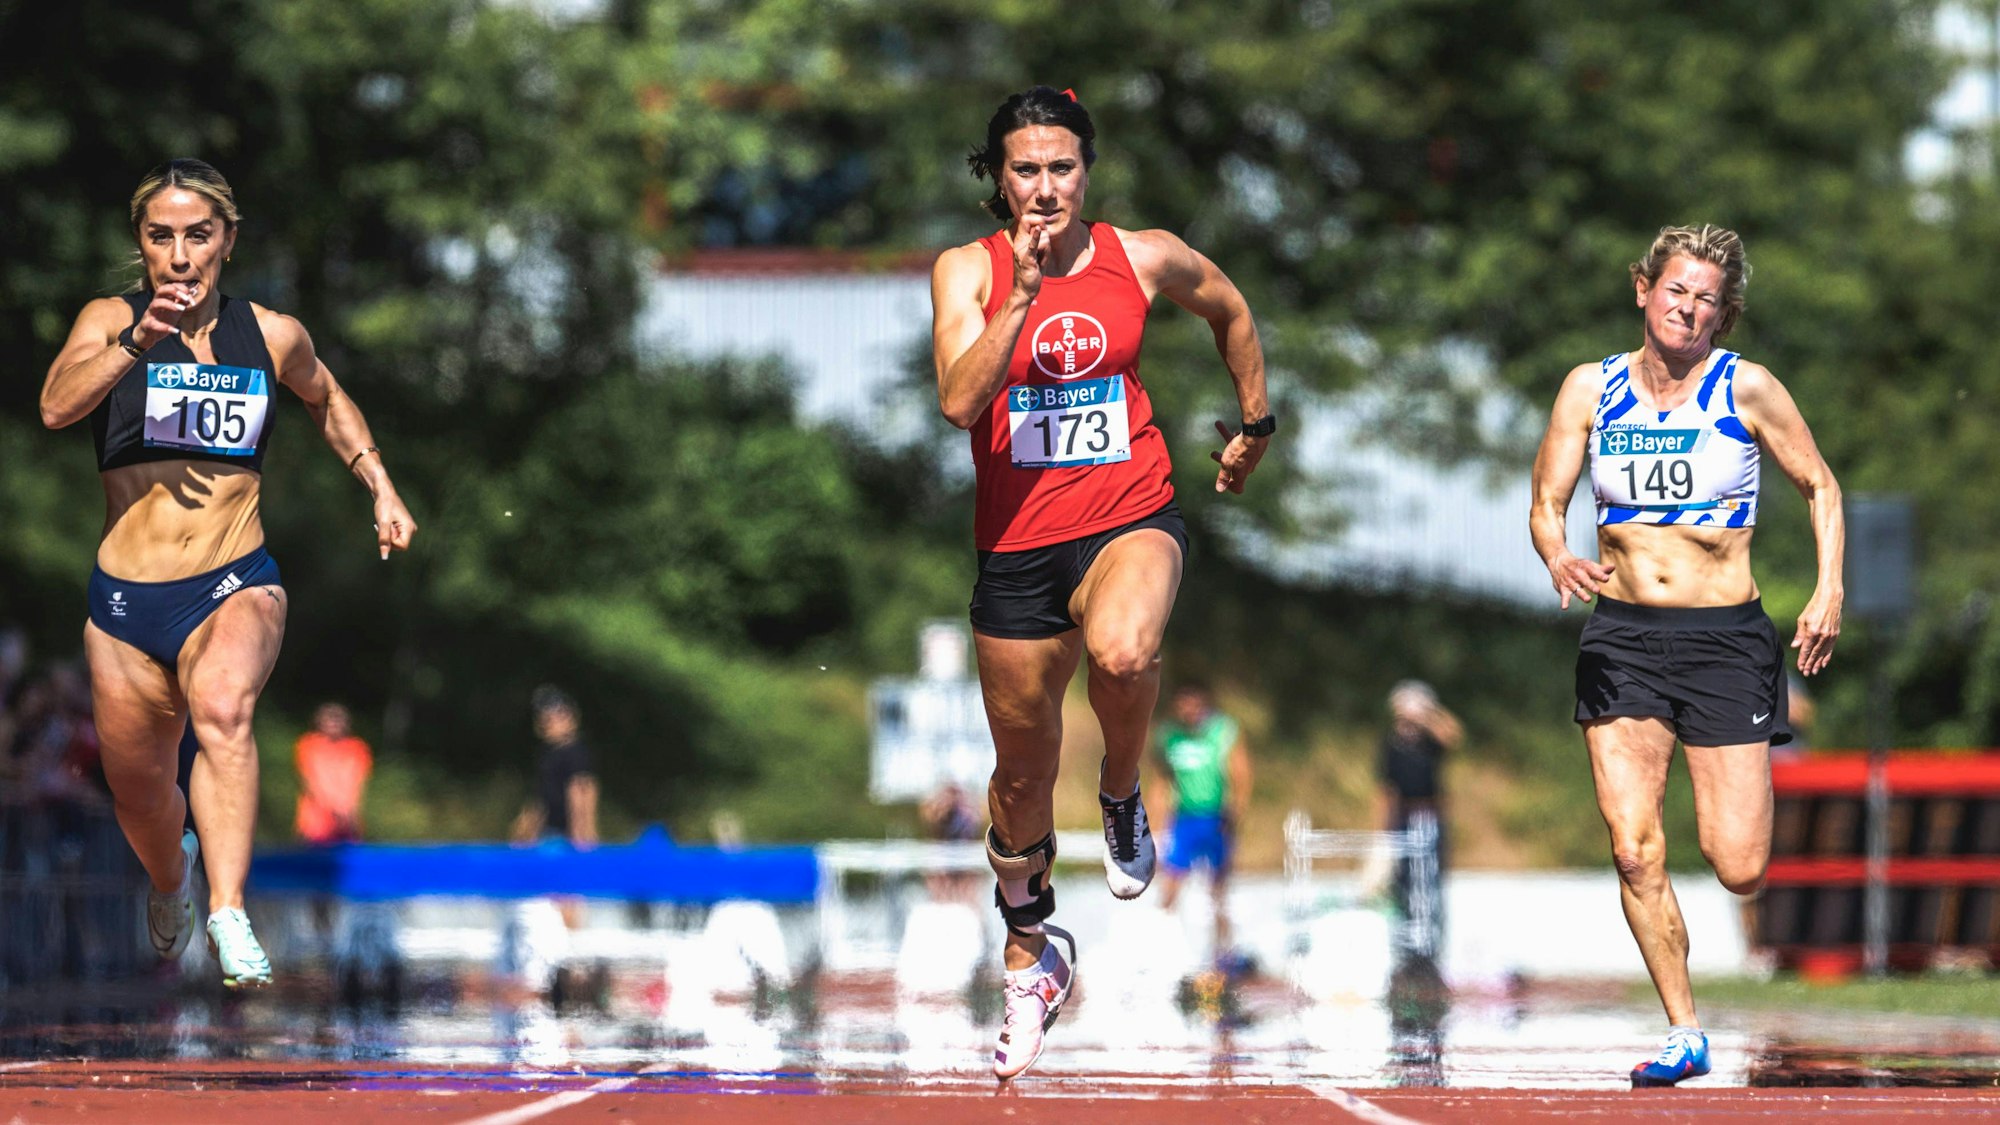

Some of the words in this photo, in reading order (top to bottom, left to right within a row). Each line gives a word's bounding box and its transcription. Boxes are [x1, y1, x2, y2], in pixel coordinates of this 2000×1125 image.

[1038, 336, 1101, 354] BAYER
[1062, 317, 1076, 373] BAYER
[185, 367, 239, 391] Bayer
[1044, 386, 1097, 407] Bayer
[172, 396, 246, 444] 105
[1033, 410, 1110, 457] 173
[1632, 433, 1685, 453] Bayer
[1620, 459, 1693, 500] 149
